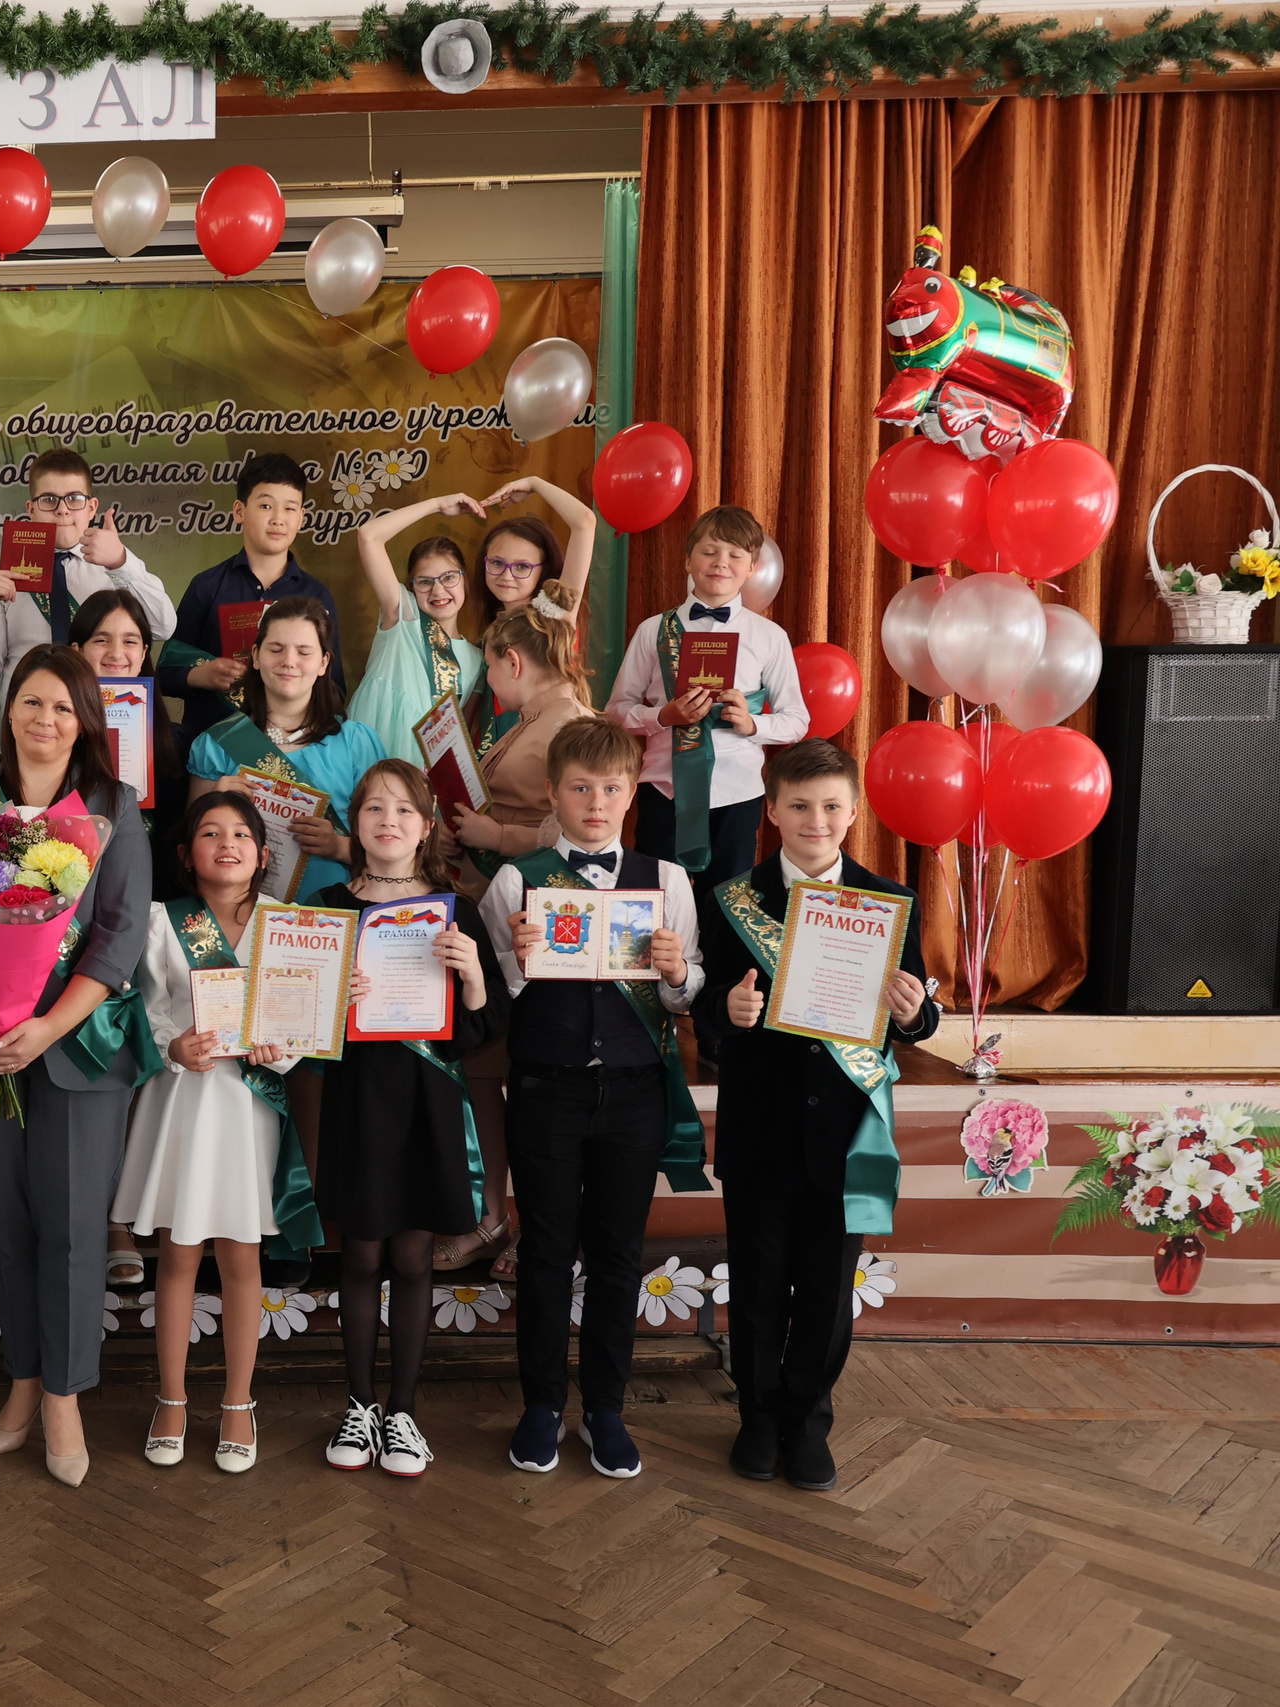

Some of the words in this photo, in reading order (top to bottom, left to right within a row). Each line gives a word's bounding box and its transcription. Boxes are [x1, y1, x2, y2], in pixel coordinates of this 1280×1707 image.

[7, 401, 401, 444] общеобразовательное
[331, 449, 428, 482] №20
[427, 716, 457, 753] ГРАМОТА
[254, 796, 306, 819] РАМОТА
[378, 929, 428, 939] ГРАМОТА
[805, 910, 886, 938] ГРАМОТА
[269, 931, 339, 951] ГРАМОТА
